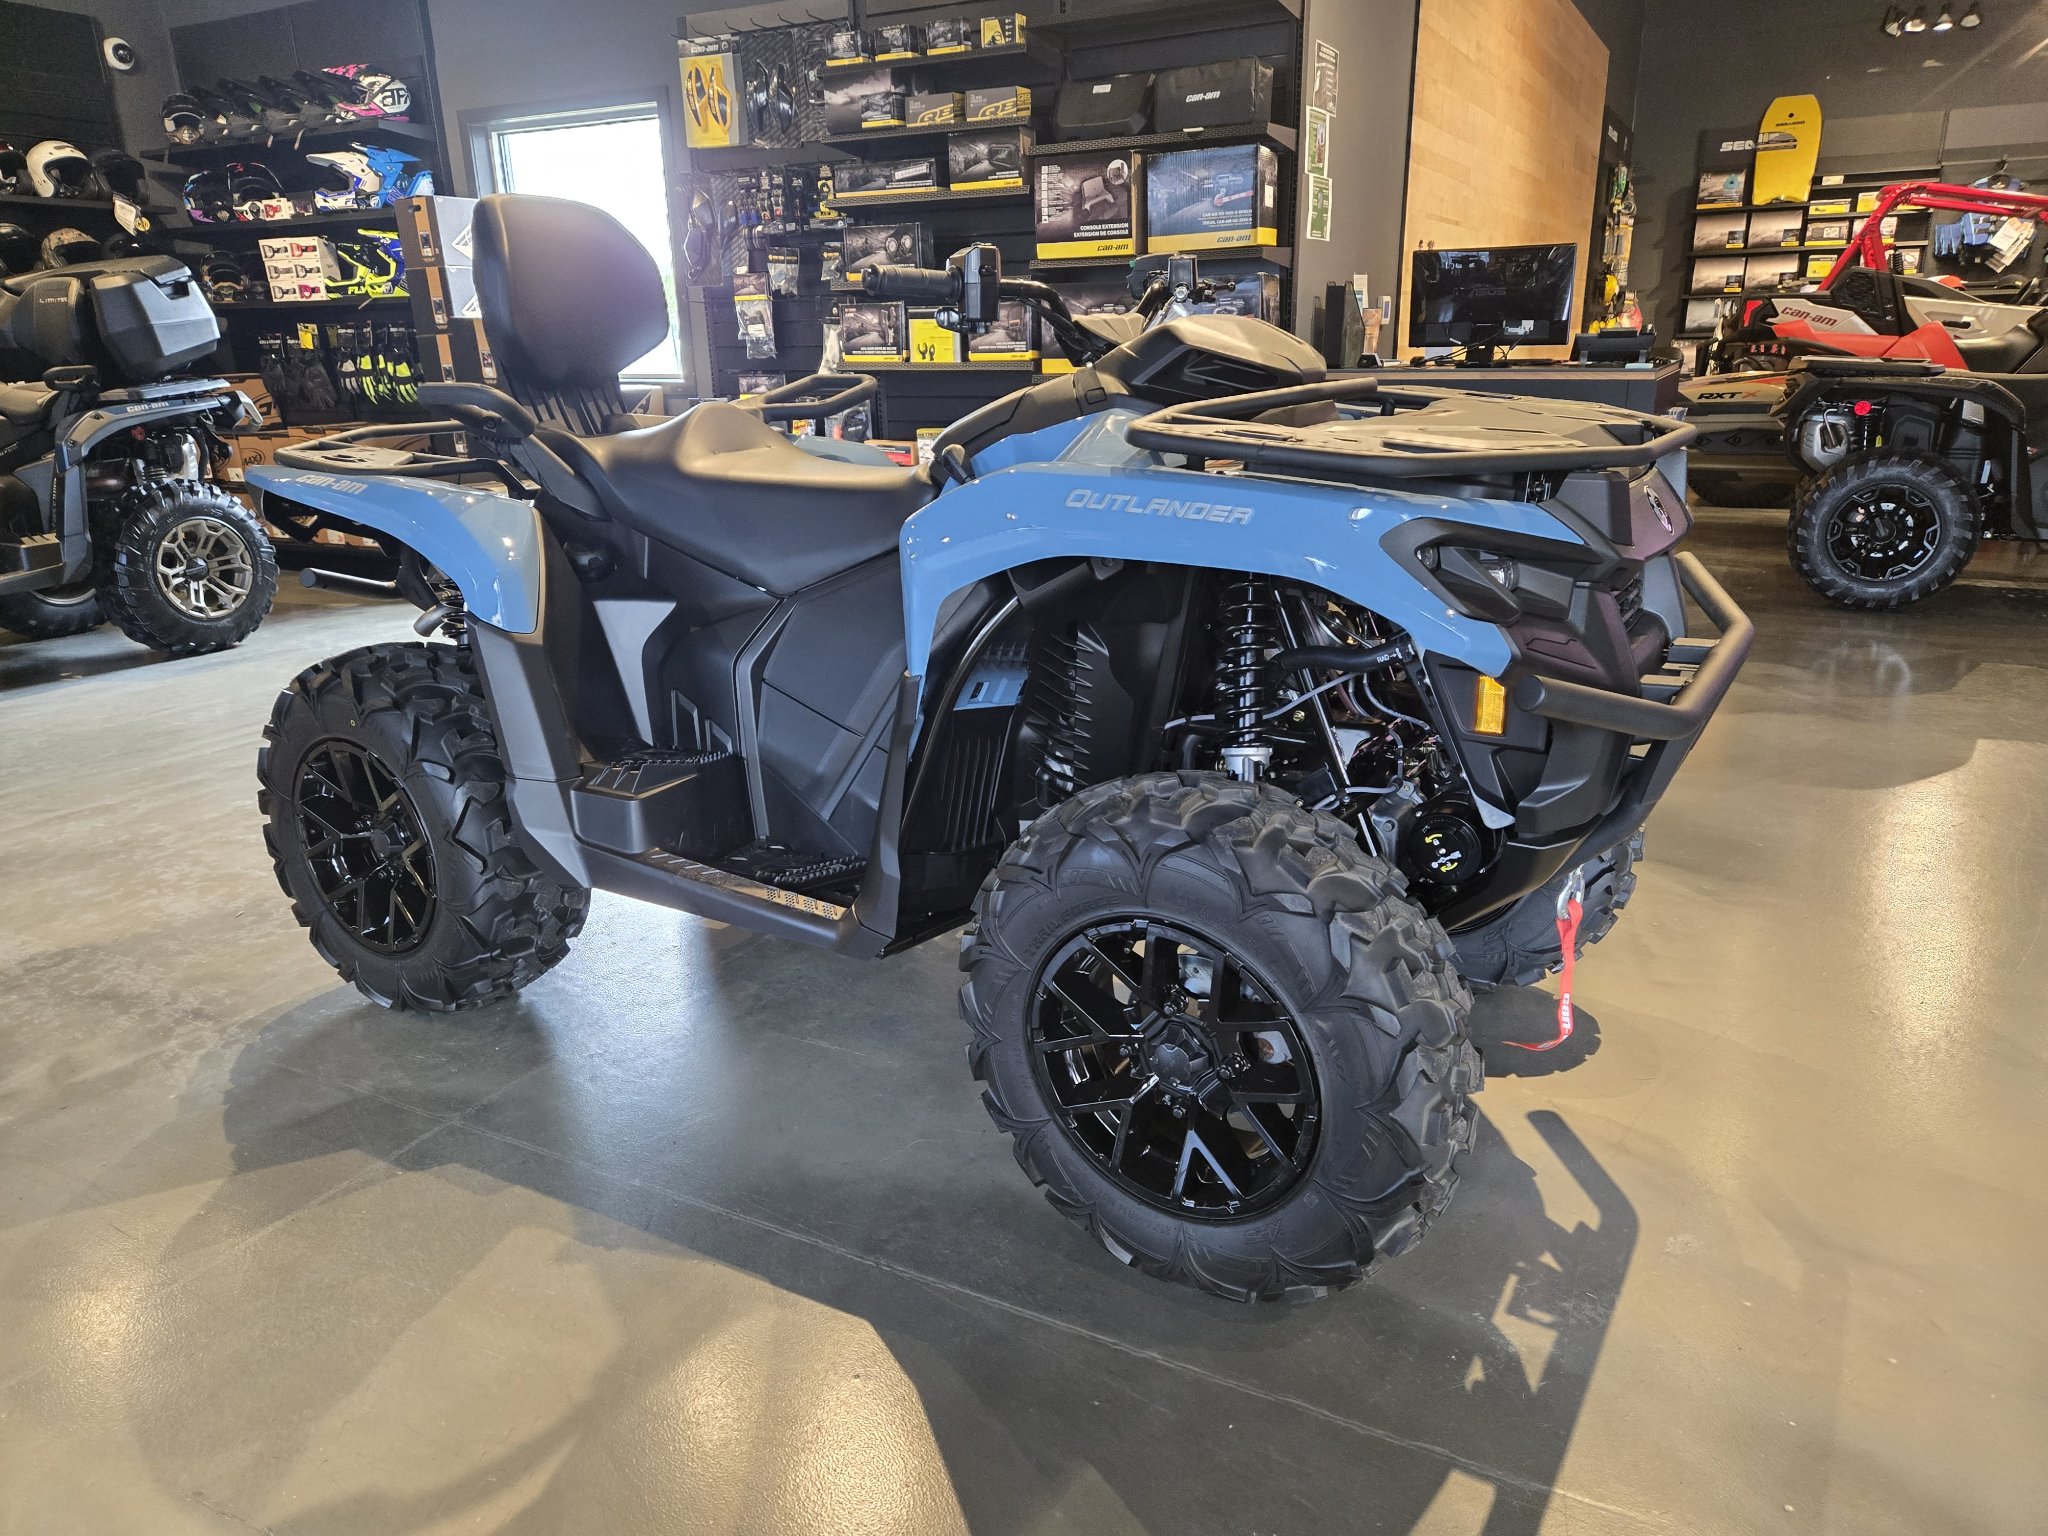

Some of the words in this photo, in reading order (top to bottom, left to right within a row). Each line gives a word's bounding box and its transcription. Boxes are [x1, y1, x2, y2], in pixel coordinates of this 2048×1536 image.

[1185, 90, 1221, 103] can-am
[1102, 222, 1129, 230] EXTENSION
[1217, 234, 1252, 243] can-am
[1097, 244, 1129, 252] can-am
[1780, 306, 1838, 327] can-am
[1697, 391, 1743, 400] RXT
[126, 401, 170, 413] can-am
[296, 473, 369, 495] can-am
[1065, 488, 1254, 525] OUTLANDER
